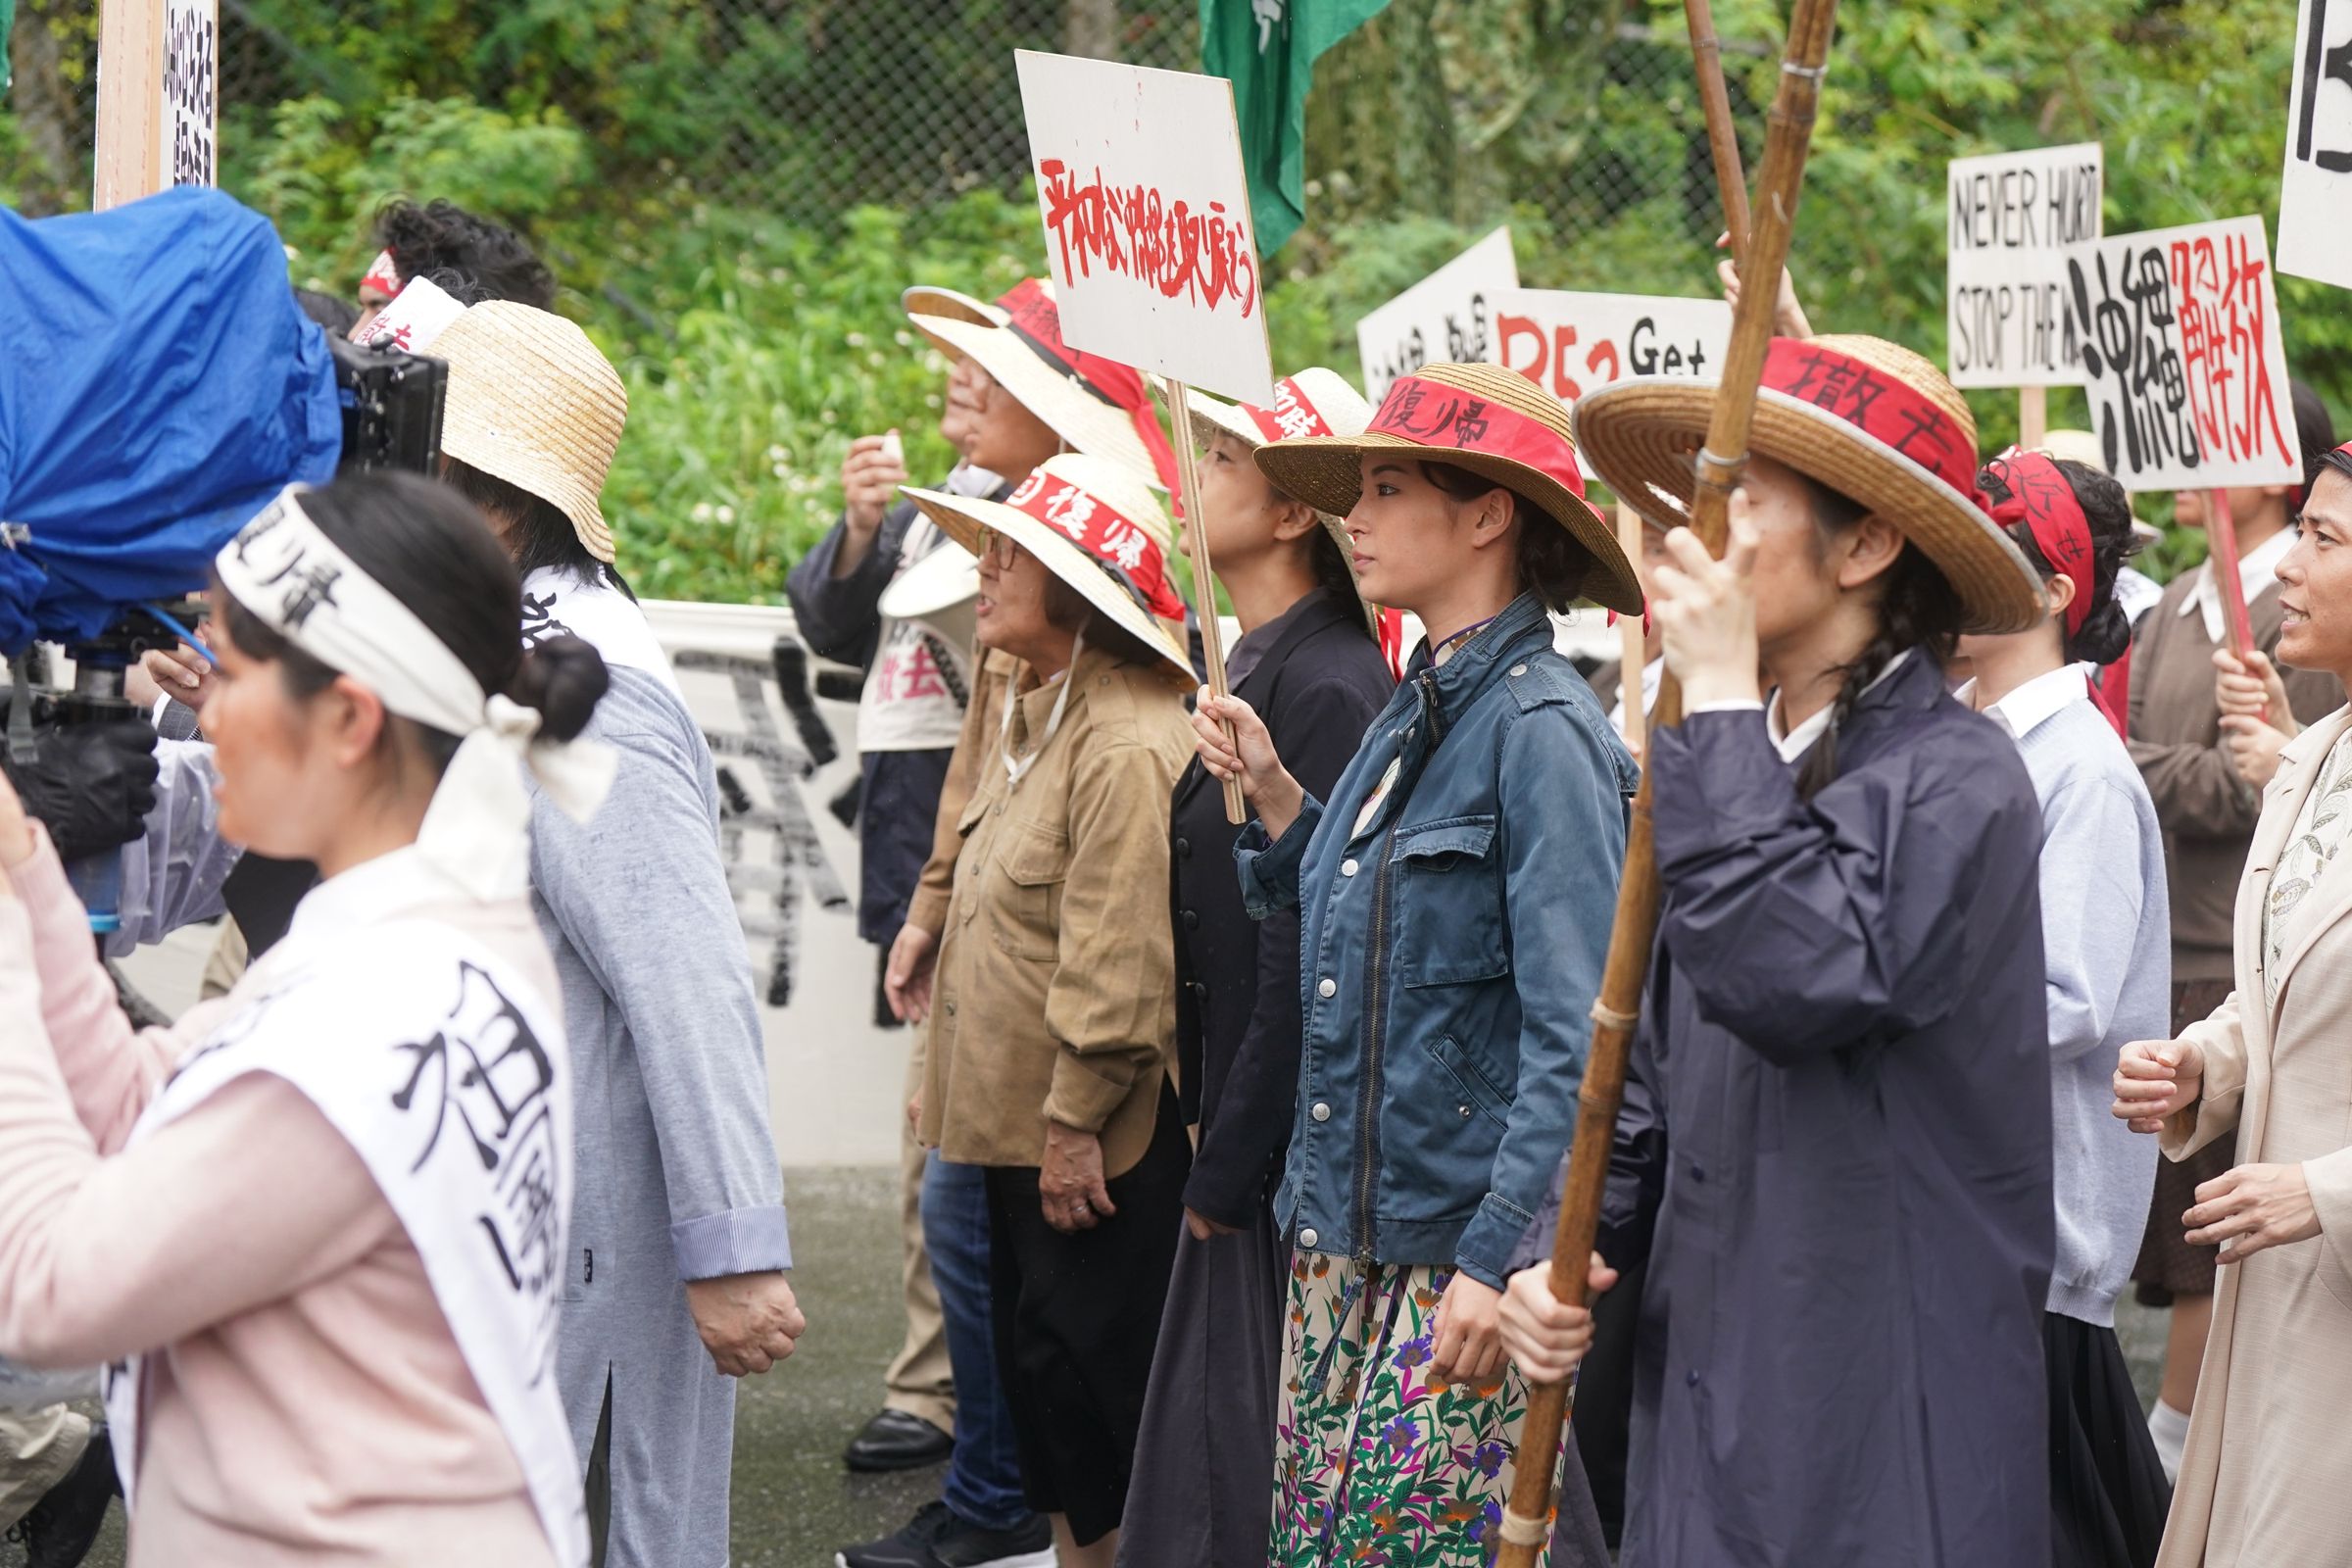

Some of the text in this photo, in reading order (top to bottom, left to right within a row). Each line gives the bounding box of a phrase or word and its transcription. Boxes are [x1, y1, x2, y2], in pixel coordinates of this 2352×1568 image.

[1954, 169, 2037, 249] NEVER
[1630, 317, 1706, 375] Get
[1955, 283, 2014, 372] STOP
[1381, 380, 1490, 449] 復帰
